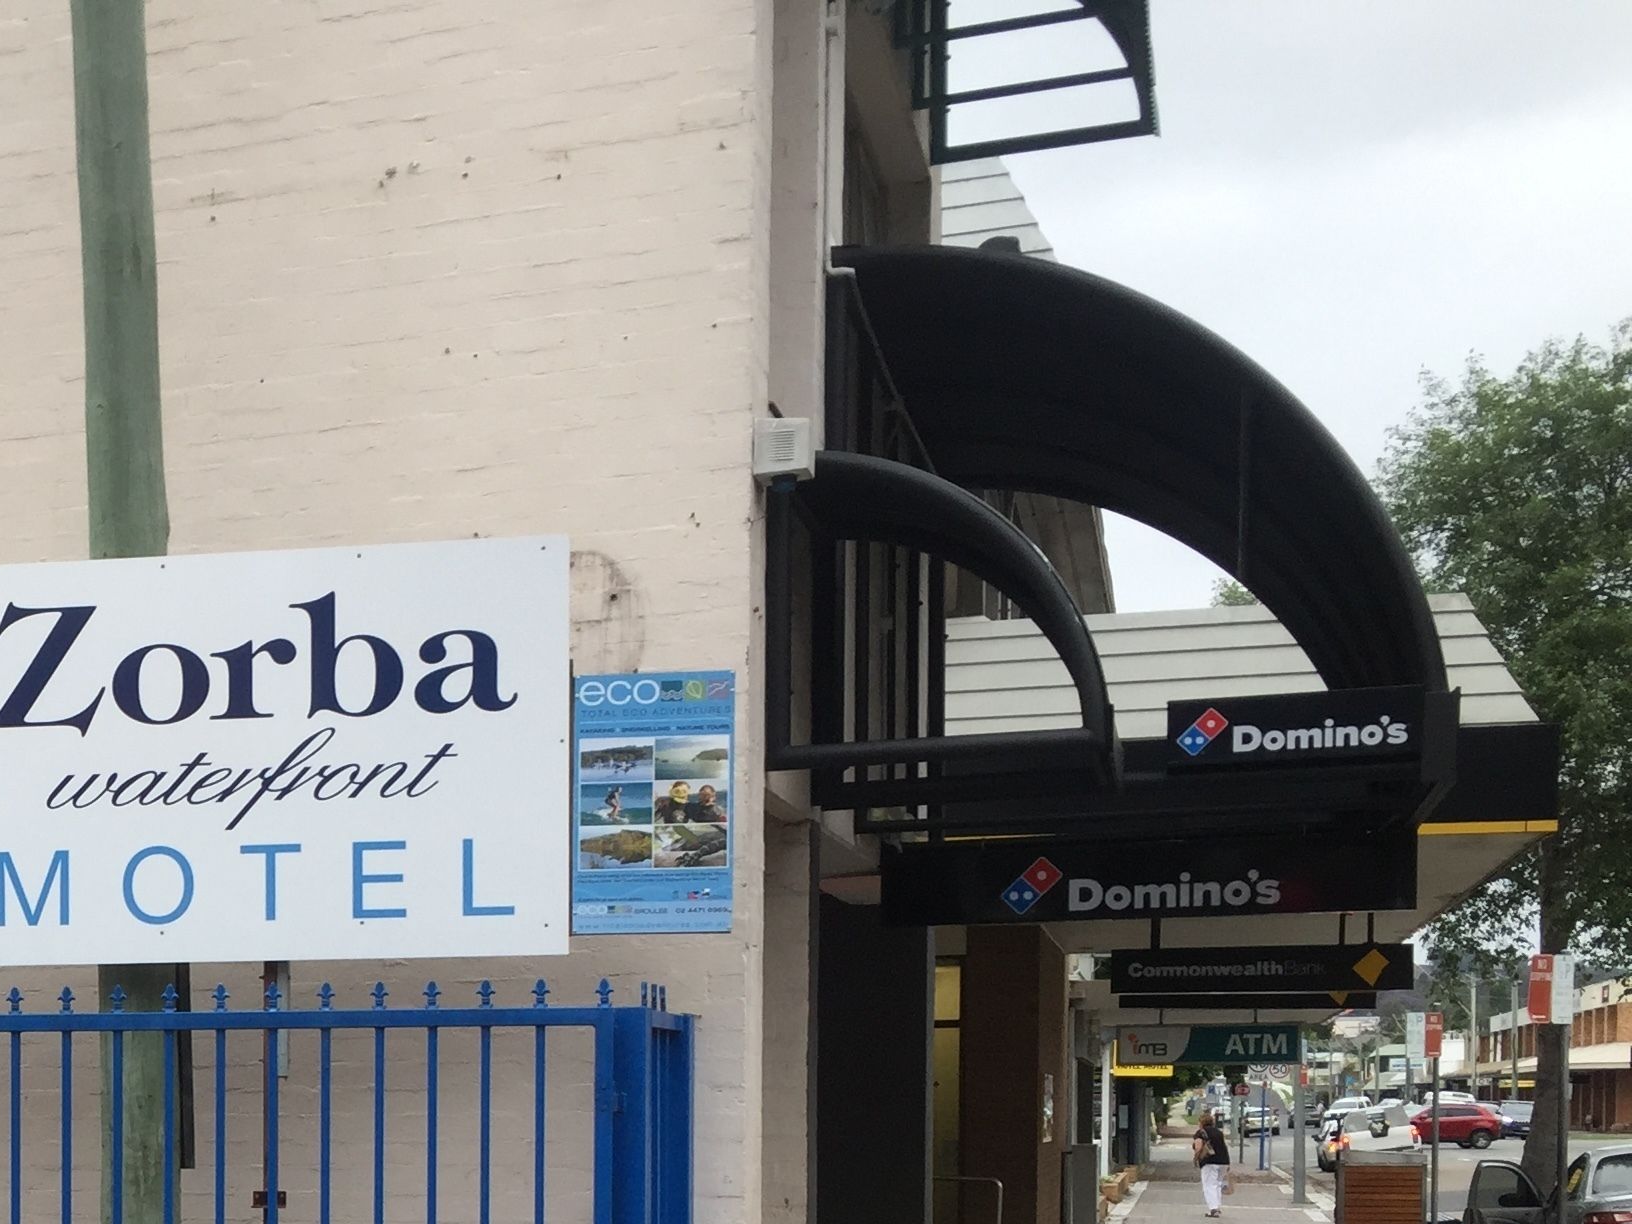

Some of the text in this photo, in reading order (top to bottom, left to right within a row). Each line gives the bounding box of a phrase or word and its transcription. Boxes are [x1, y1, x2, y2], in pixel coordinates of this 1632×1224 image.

[578, 679, 660, 706] eco
[581, 705, 733, 718] TOTAL ECO ADVENTURES
[1232, 715, 1409, 754] Domino's
[45, 727, 458, 831] waterfront
[1068, 869, 1282, 913] Domino's
[1225, 1033, 1288, 1055] ATM
[1272, 1064, 1287, 1074] 50
